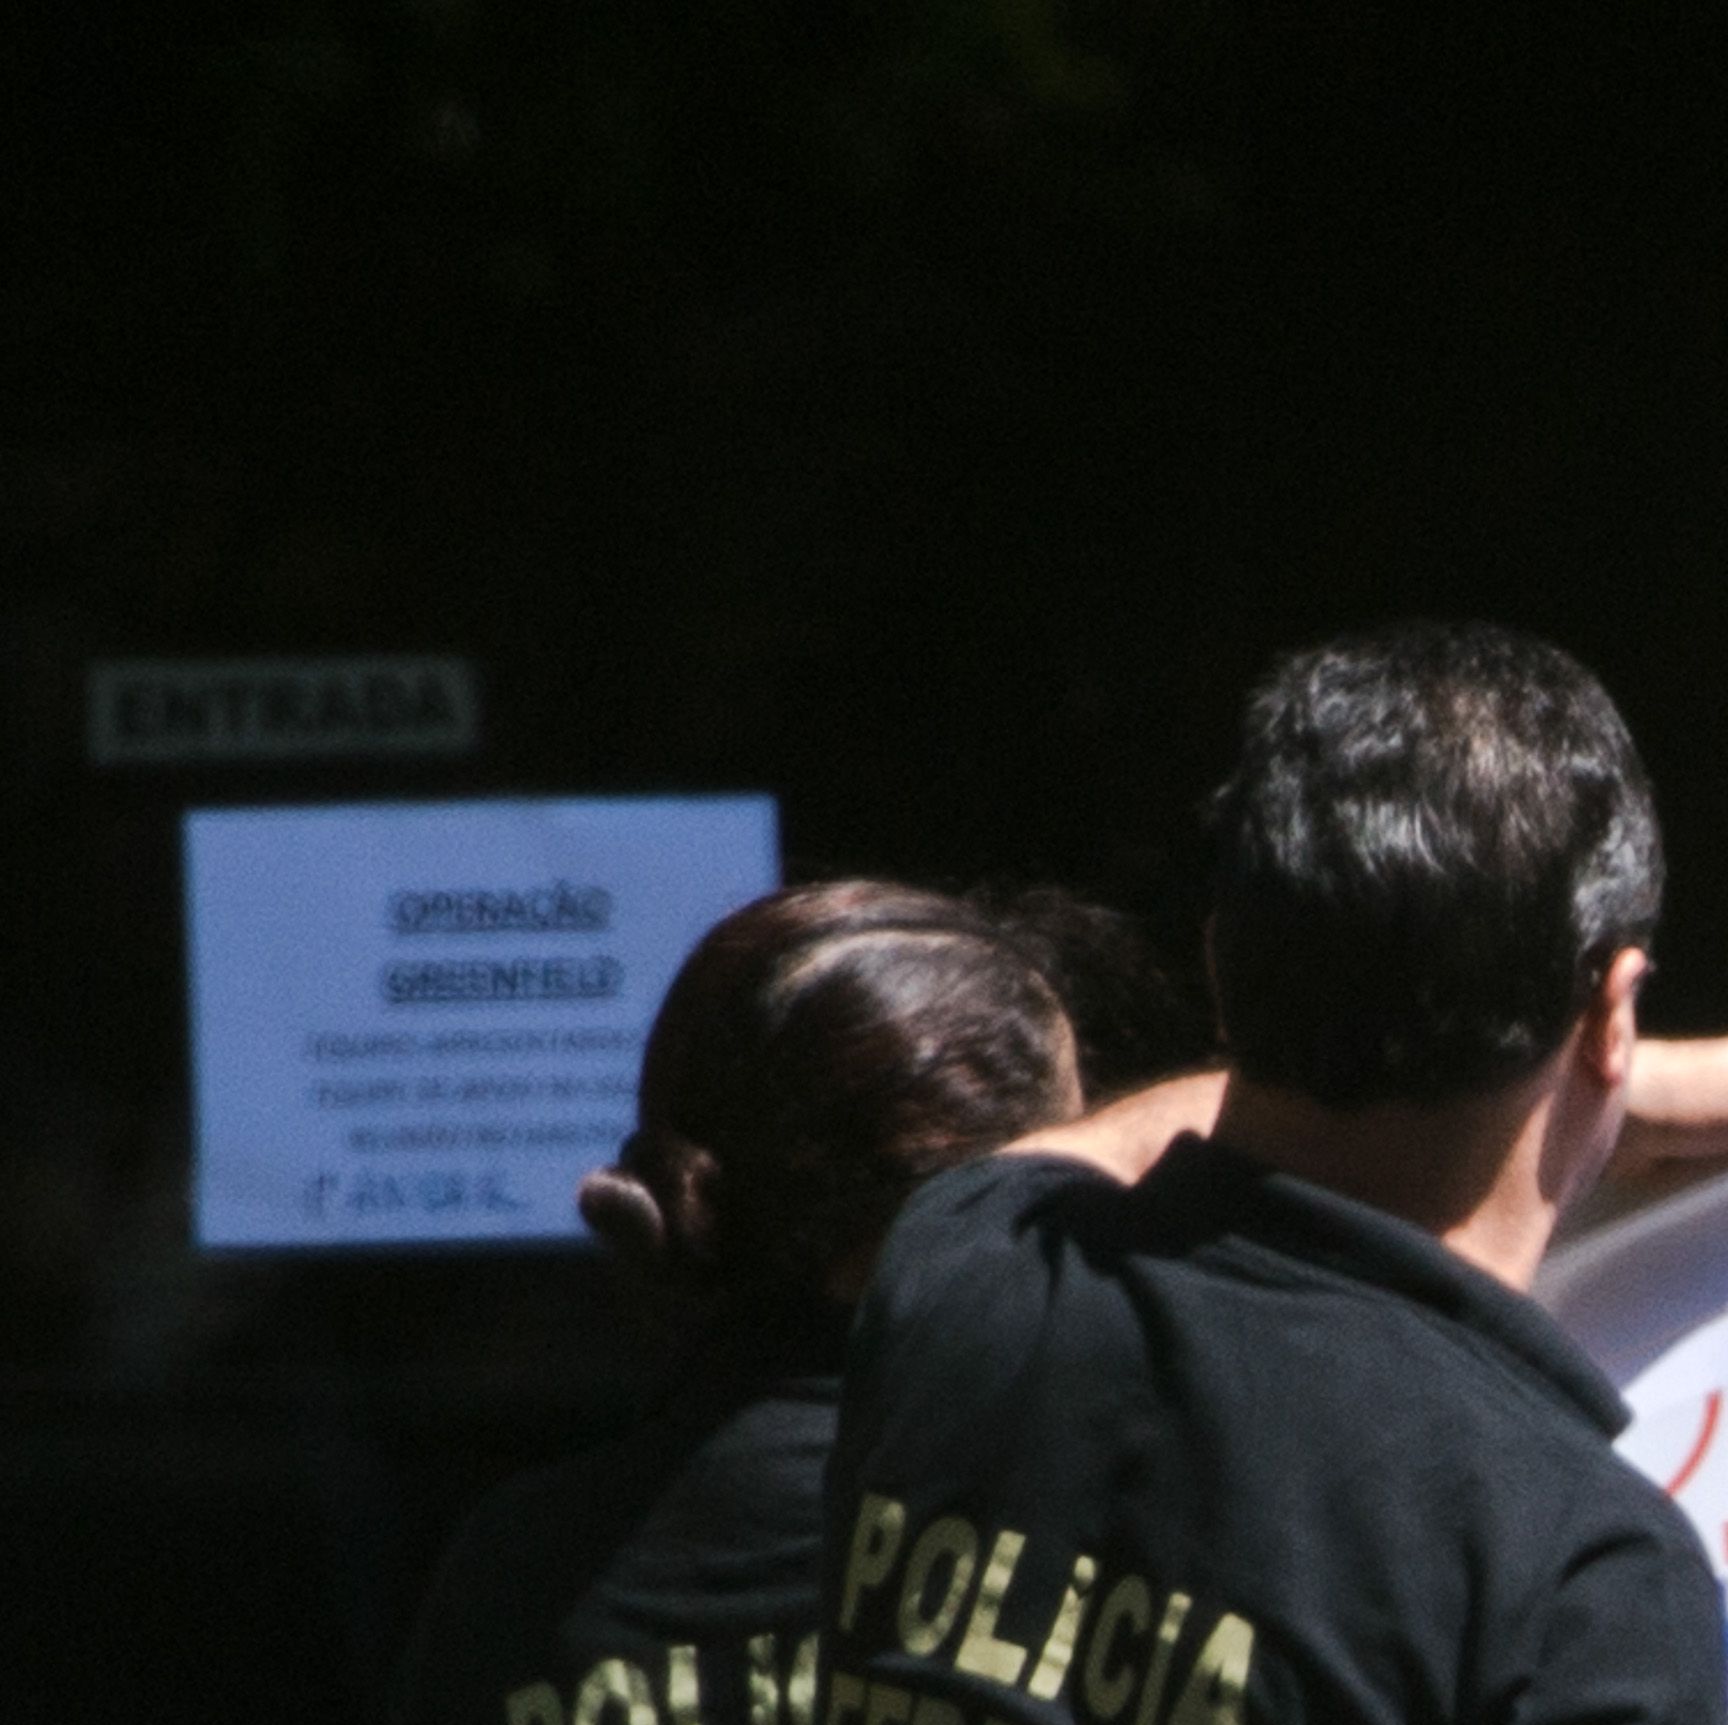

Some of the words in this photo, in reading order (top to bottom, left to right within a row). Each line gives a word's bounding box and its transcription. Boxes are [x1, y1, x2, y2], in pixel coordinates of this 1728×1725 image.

[113, 672, 459, 738] ENTRADA
[391, 879, 613, 933] OPERAÇÃO
[383, 955, 625, 1002] GREENFIELD
